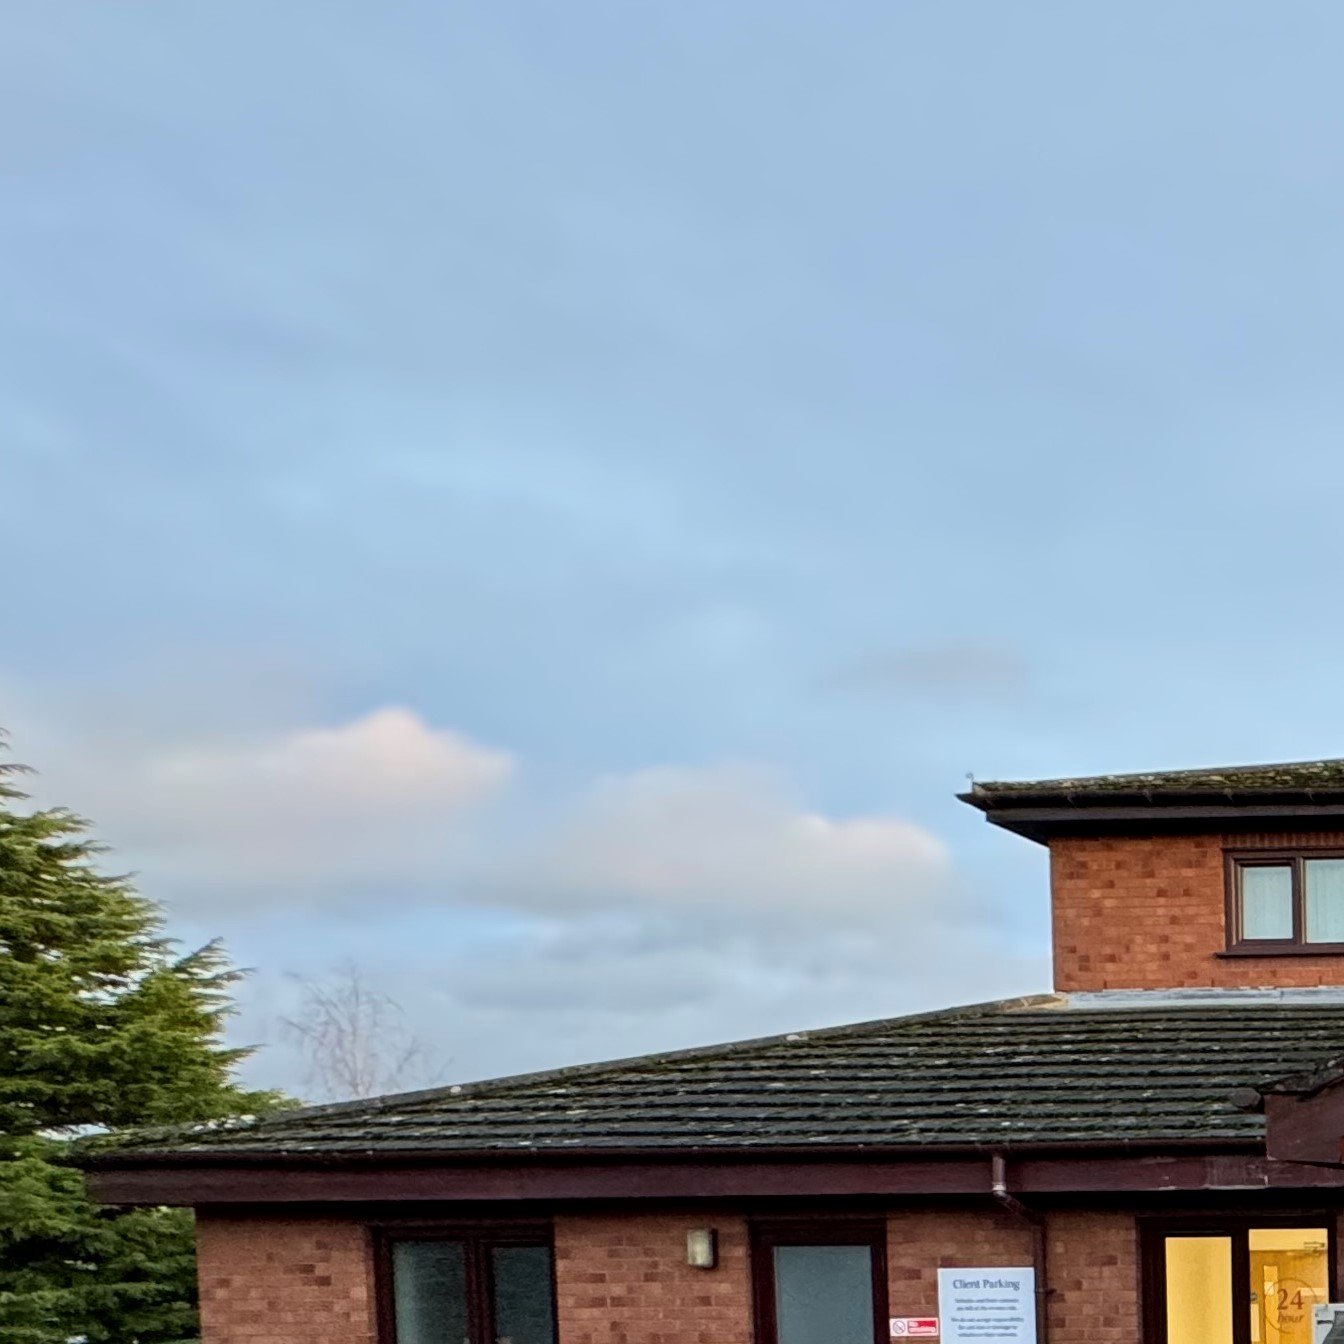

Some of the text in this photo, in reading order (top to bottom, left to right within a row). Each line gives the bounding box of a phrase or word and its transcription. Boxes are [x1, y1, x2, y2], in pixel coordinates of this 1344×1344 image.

[952, 1278, 1021, 1291] Client Parking
[1277, 1288, 1305, 1310] 24
